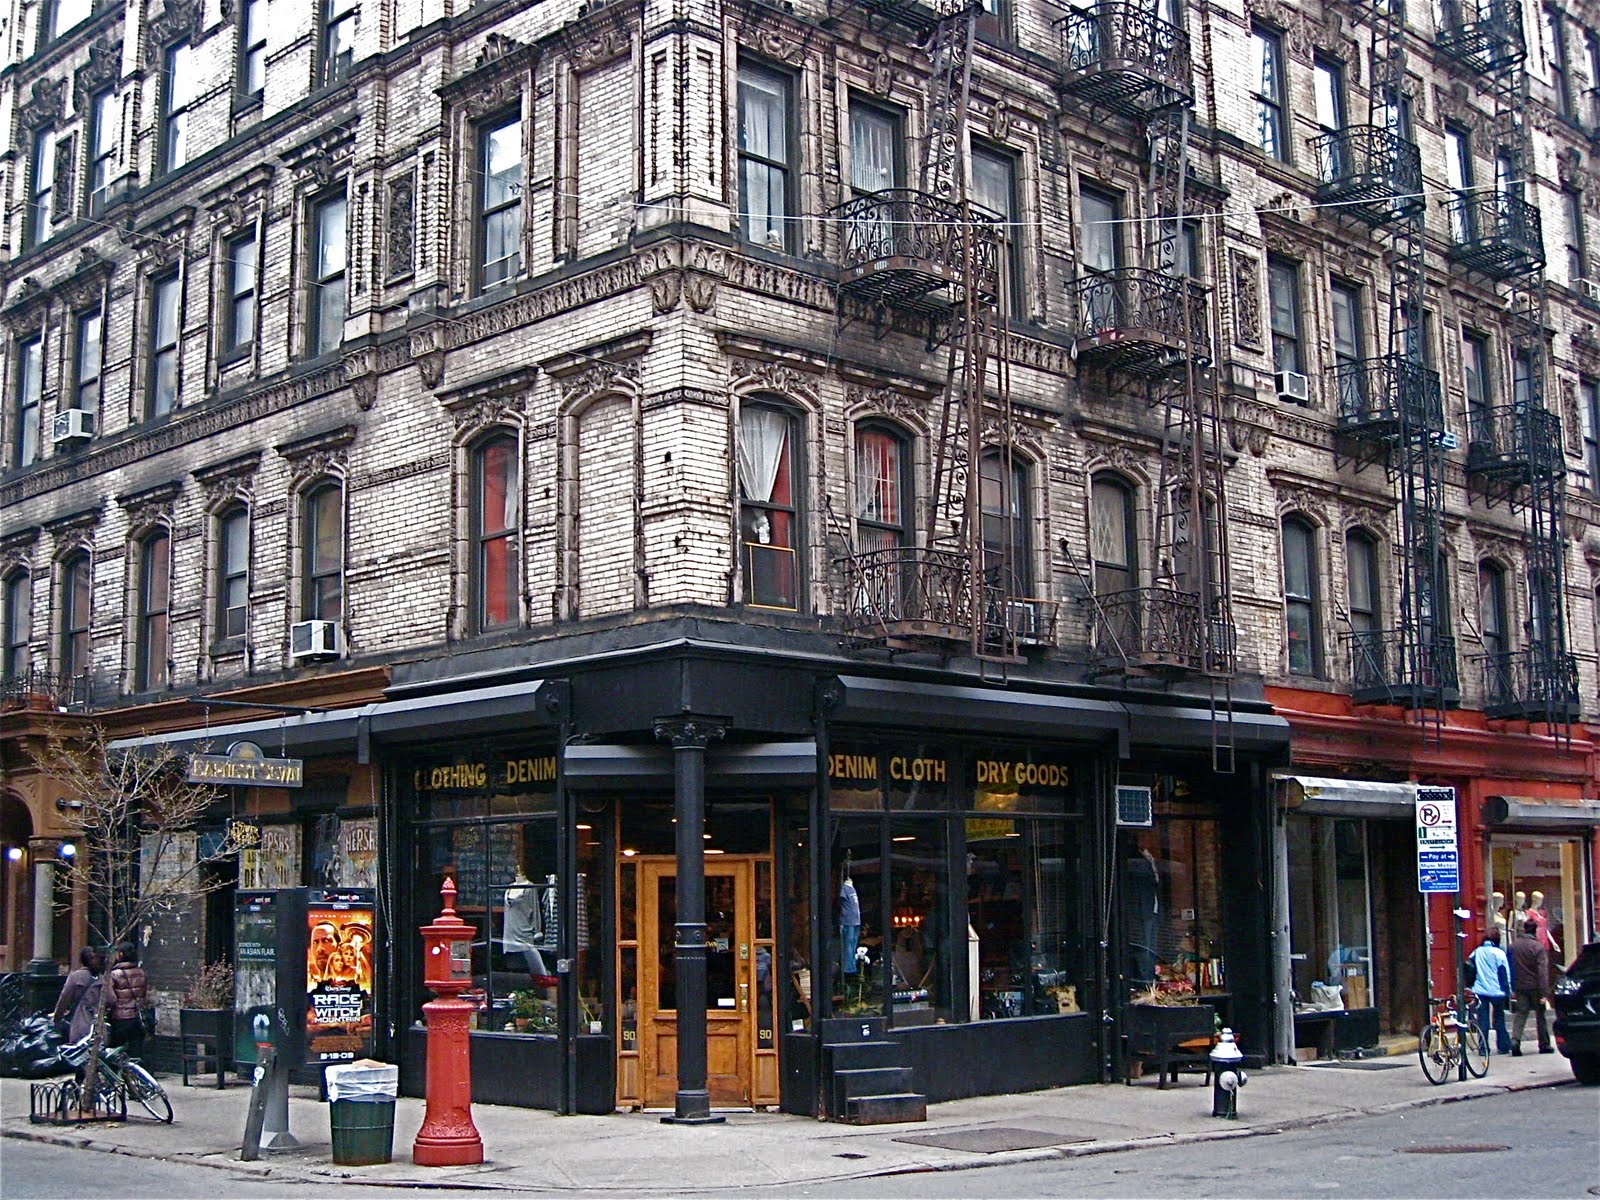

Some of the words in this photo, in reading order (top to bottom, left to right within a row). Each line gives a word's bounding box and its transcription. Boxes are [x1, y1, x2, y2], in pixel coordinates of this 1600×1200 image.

[506, 757, 556, 784] DENIM
[828, 754, 877, 780] DENIM
[890, 756, 946, 782] CLOTH
[977, 760, 1010, 784] DRY
[1014, 762, 1069, 787] GOODS
[313, 994, 361, 1005] RACE
[315, 1008, 361, 1017] WITCH
[623, 1031, 636, 1040] 90
[759, 1029, 772, 1039] 90
